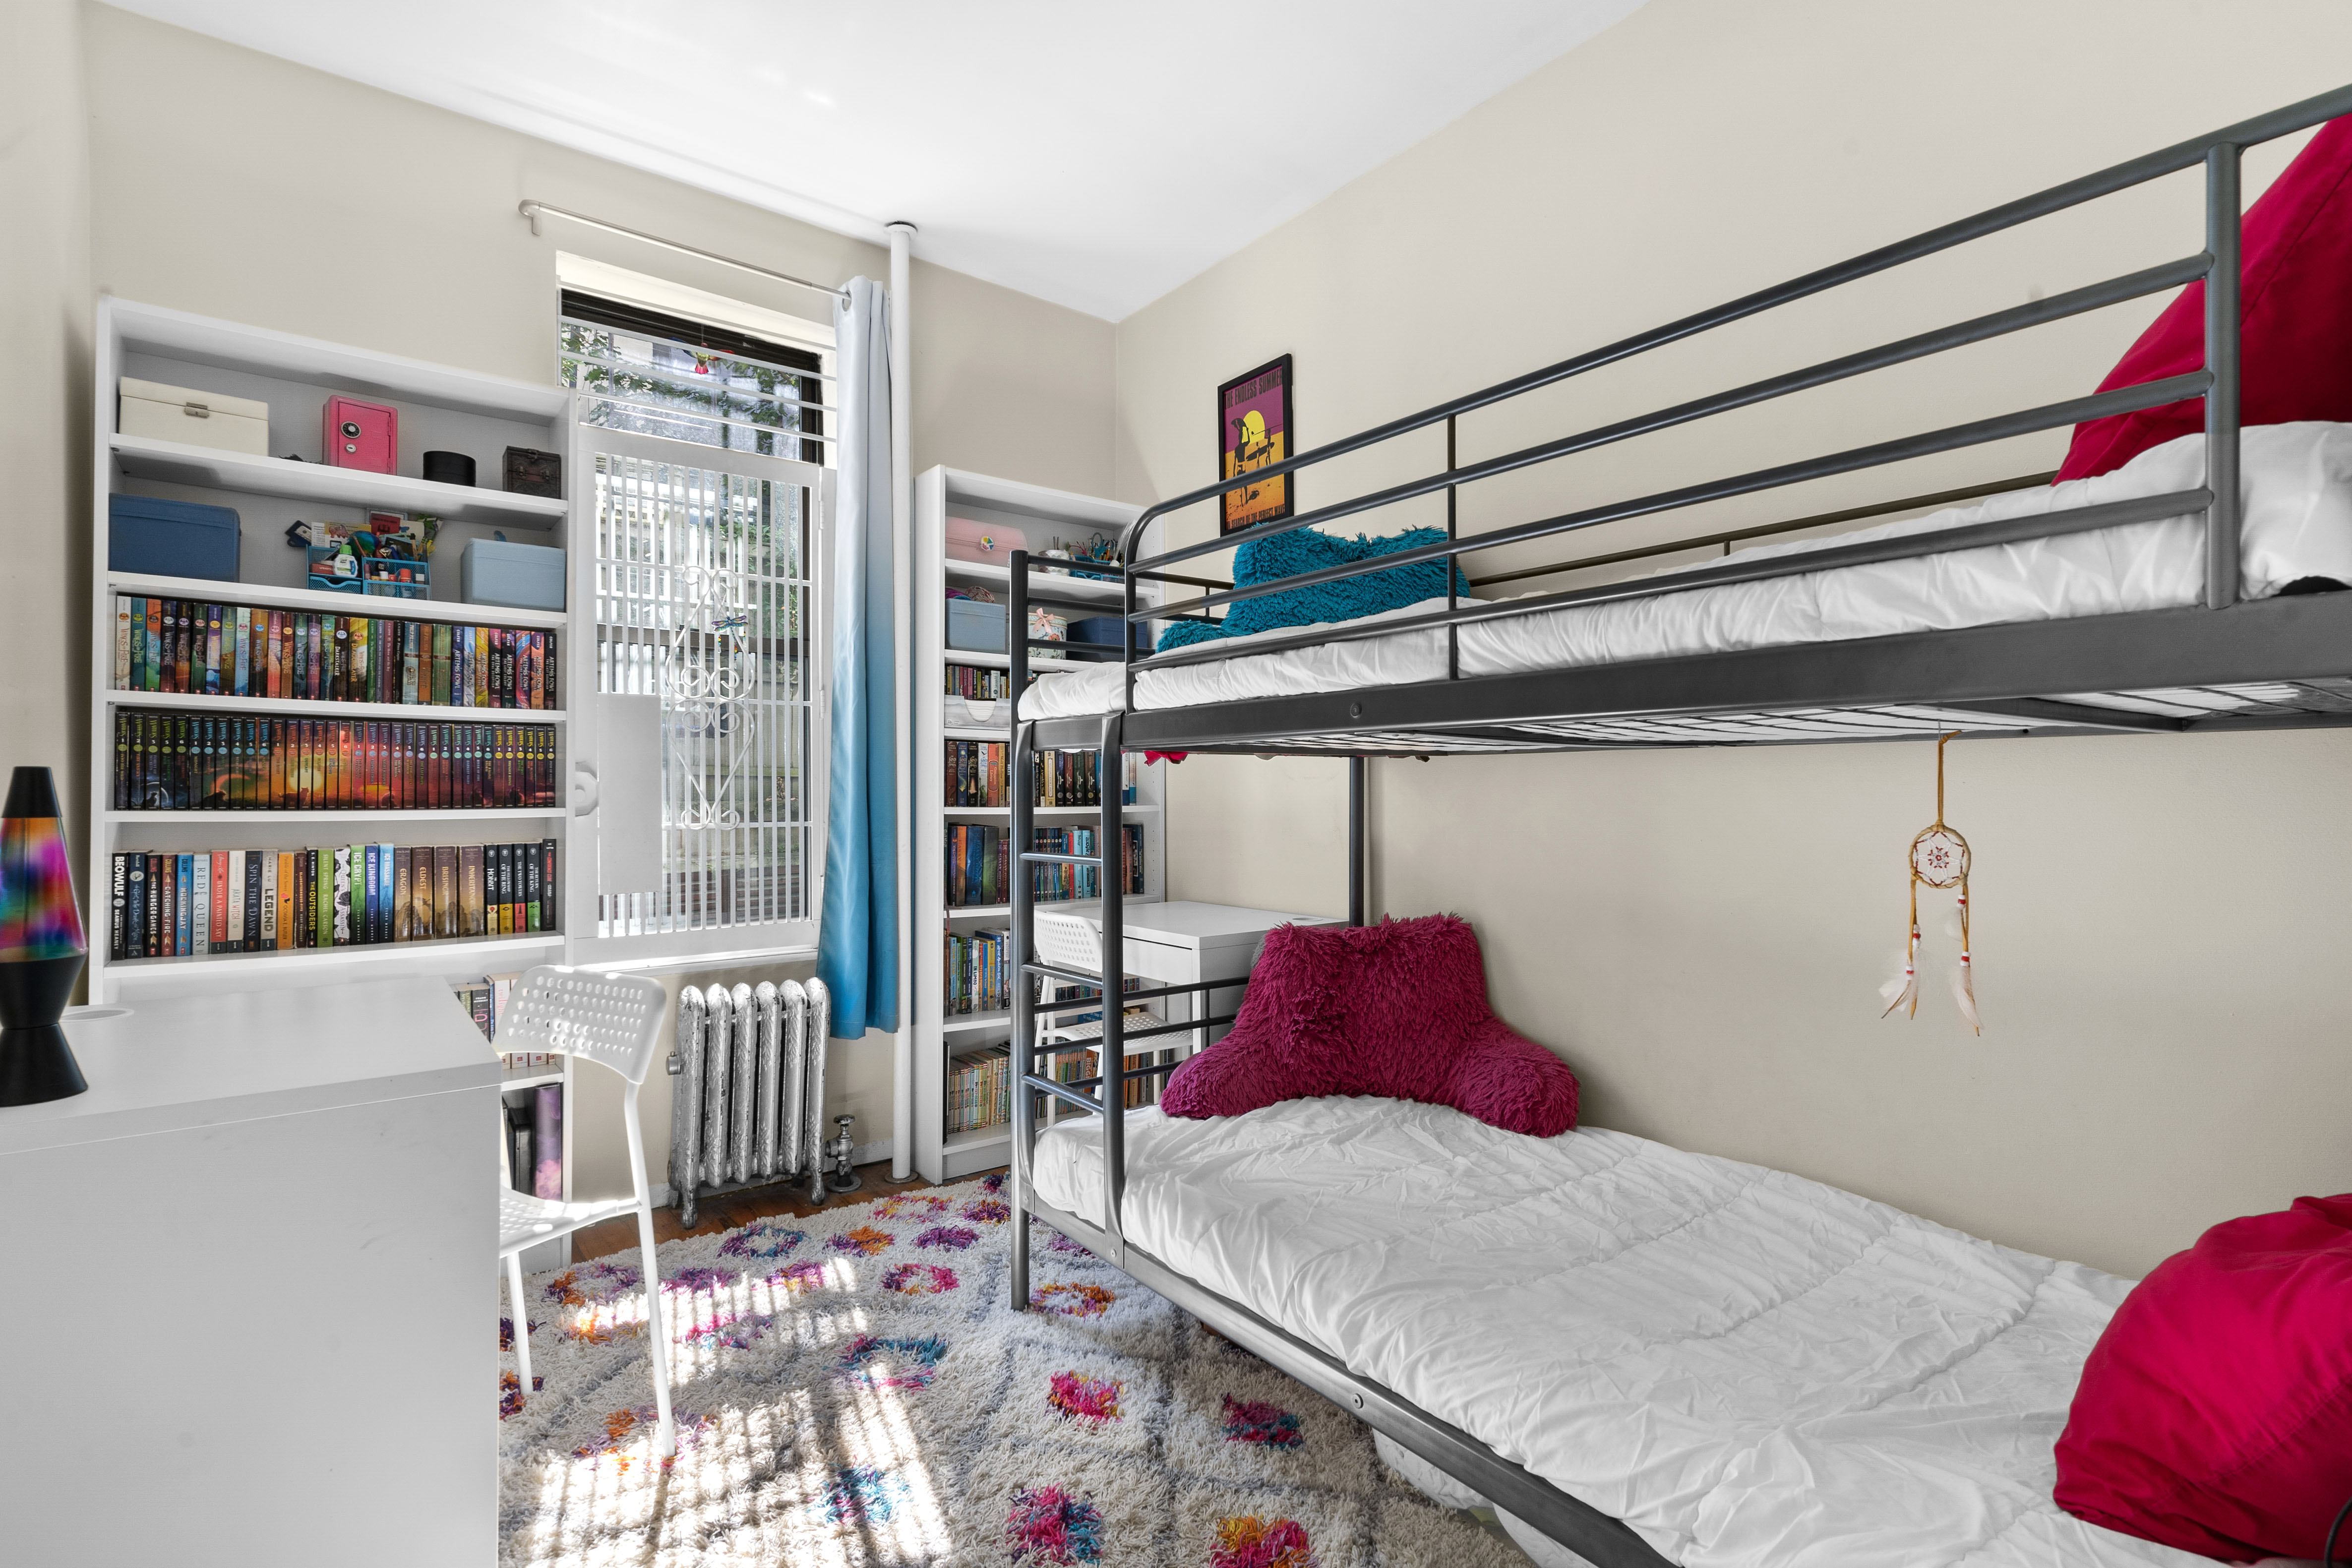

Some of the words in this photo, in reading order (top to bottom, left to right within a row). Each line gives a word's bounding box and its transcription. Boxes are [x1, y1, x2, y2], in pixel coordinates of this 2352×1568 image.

[1225, 390, 1233, 410] THE
[1235, 378, 1257, 405] ENDLESS
[1259, 367, 1283, 395] SUMMER
[1231, 515, 1245, 529] SEARCH
[1246, 514, 1250, 525] OF
[1259, 507, 1273, 521] PERFECT
[1274, 503, 1285, 516] WAVE
[165, 631, 174, 649] WINGS
[165, 653, 174, 665] FIRE
[354, 852, 362, 862] ICE
[114, 856, 125, 896] BEOWULF
[197, 867, 206, 889] RED
[248, 864, 258, 884] SPIN
[354, 864, 362, 886] CRYPT
[231, 889, 241, 903] AKATA
[249, 887, 257, 904] THE
[231, 905, 241, 919] WITCH
[248, 907, 258, 936] DAWN
[264, 889, 274, 932] LEGEND
[194, 904, 205, 946] QUEEN
